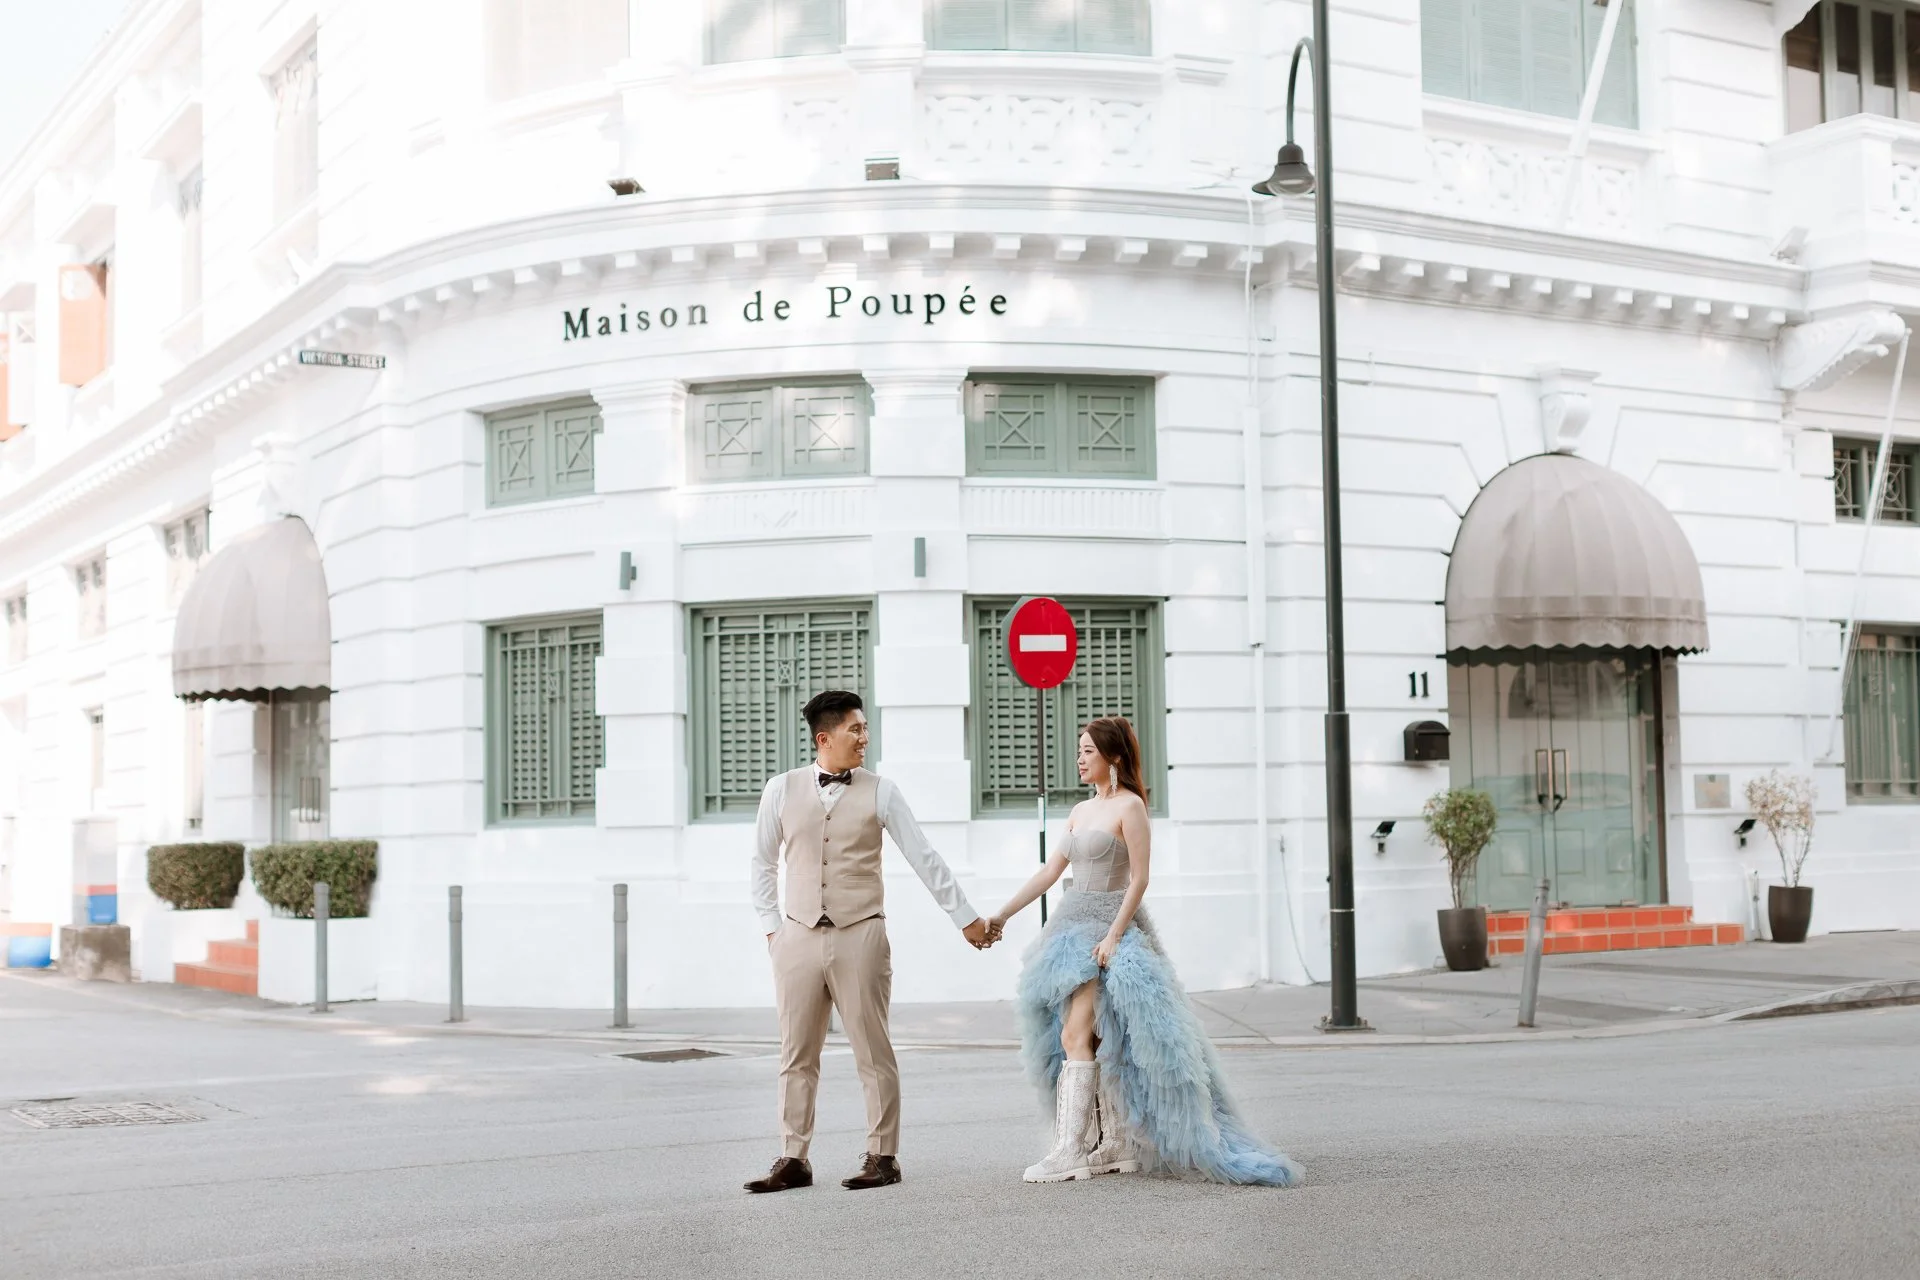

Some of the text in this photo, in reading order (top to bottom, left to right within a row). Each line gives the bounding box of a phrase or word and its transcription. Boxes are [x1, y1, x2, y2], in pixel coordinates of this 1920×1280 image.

[562, 285, 1009, 342] Maison de Poupée
[302, 351, 384, 369] VICTORIA STREET
[1408, 671, 1430, 698] 11
